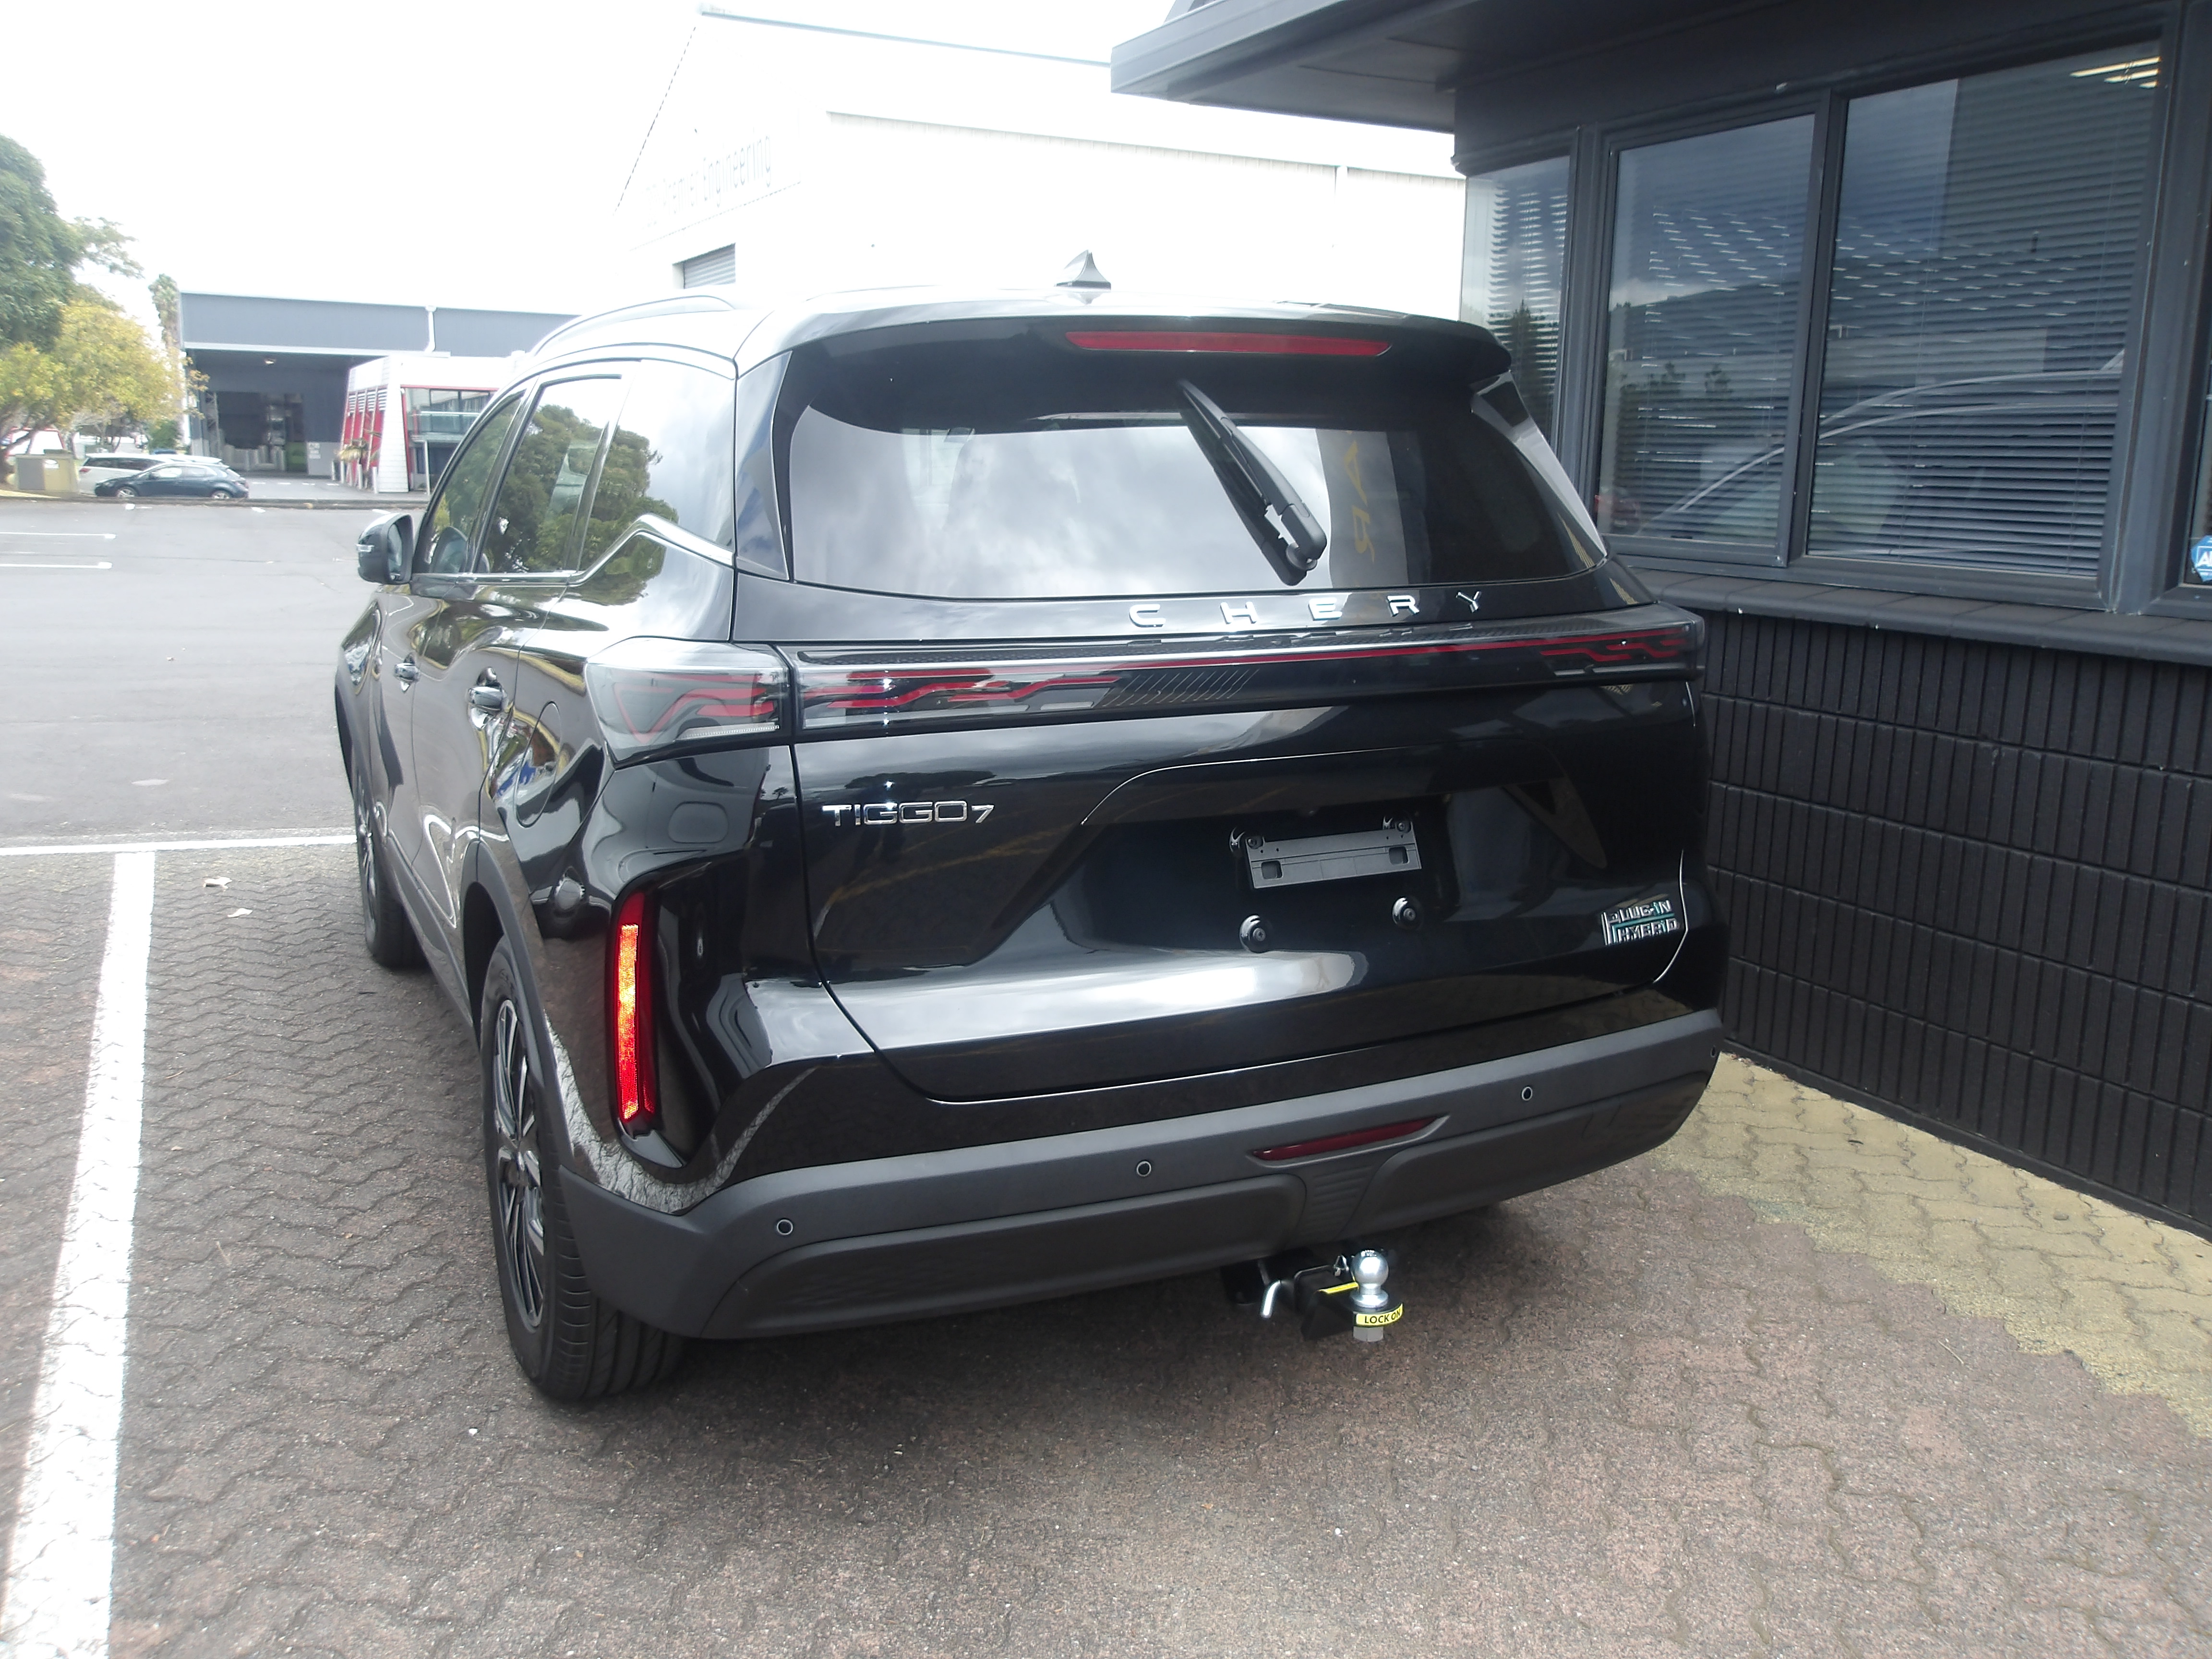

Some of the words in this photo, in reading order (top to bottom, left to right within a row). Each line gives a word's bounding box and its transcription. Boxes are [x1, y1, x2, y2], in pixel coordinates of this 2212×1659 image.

[703, 135, 771, 208] Engineering
[1129, 591, 1480, 627] CHERY
[822, 800, 968, 826] TIGGO
[971, 805, 995, 824] 7
[1365, 1314, 1390, 1324] LOCK
[1391, 1309, 1401, 1321] ON
